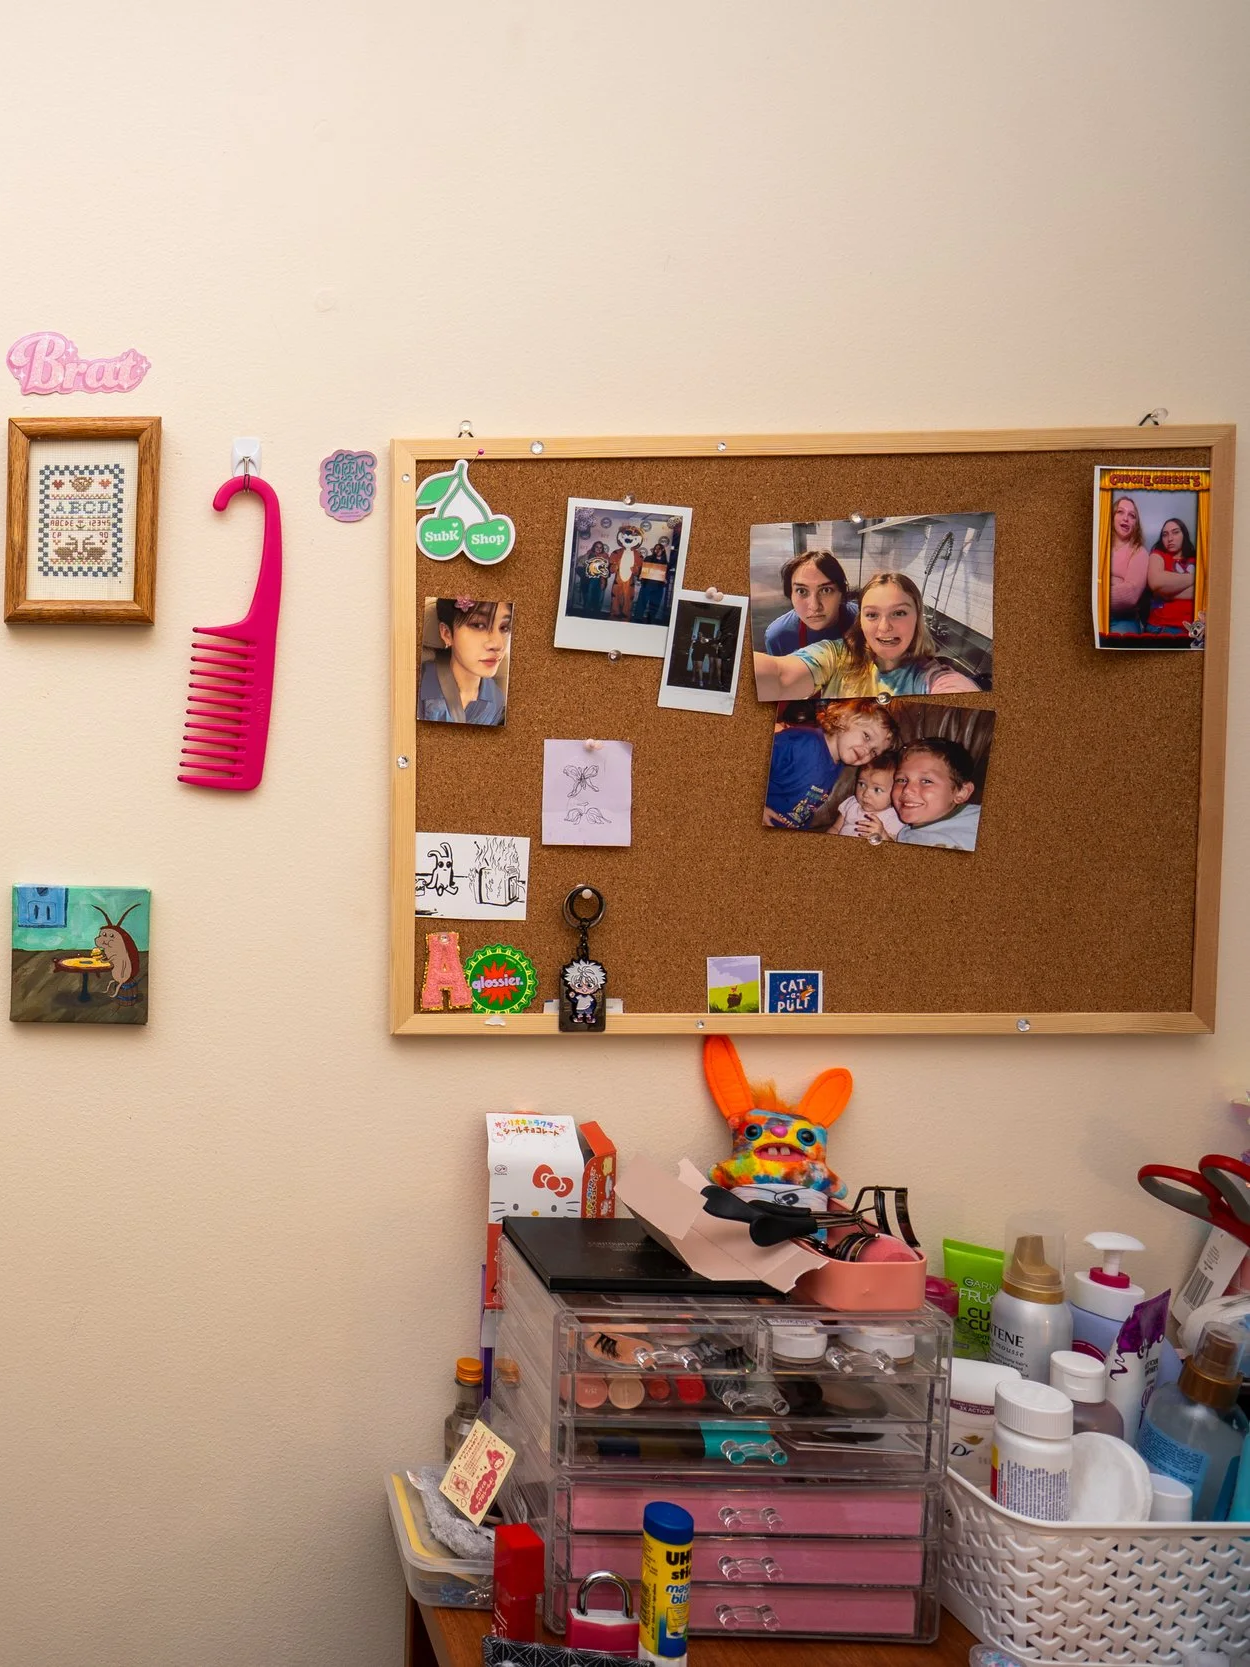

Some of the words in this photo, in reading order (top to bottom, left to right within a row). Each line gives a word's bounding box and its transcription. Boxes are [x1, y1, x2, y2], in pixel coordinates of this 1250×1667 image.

[10, 333, 140, 391] Brat
[1109, 474, 1144, 486] CHUCK
[51, 500, 111, 514] ABCD
[50, 519, 74, 527] ABCDE
[89, 519, 111, 527] 12345
[424, 530, 460, 543] SubK
[471, 534, 506, 546] Shop
[779, 978, 806, 993] CAT
